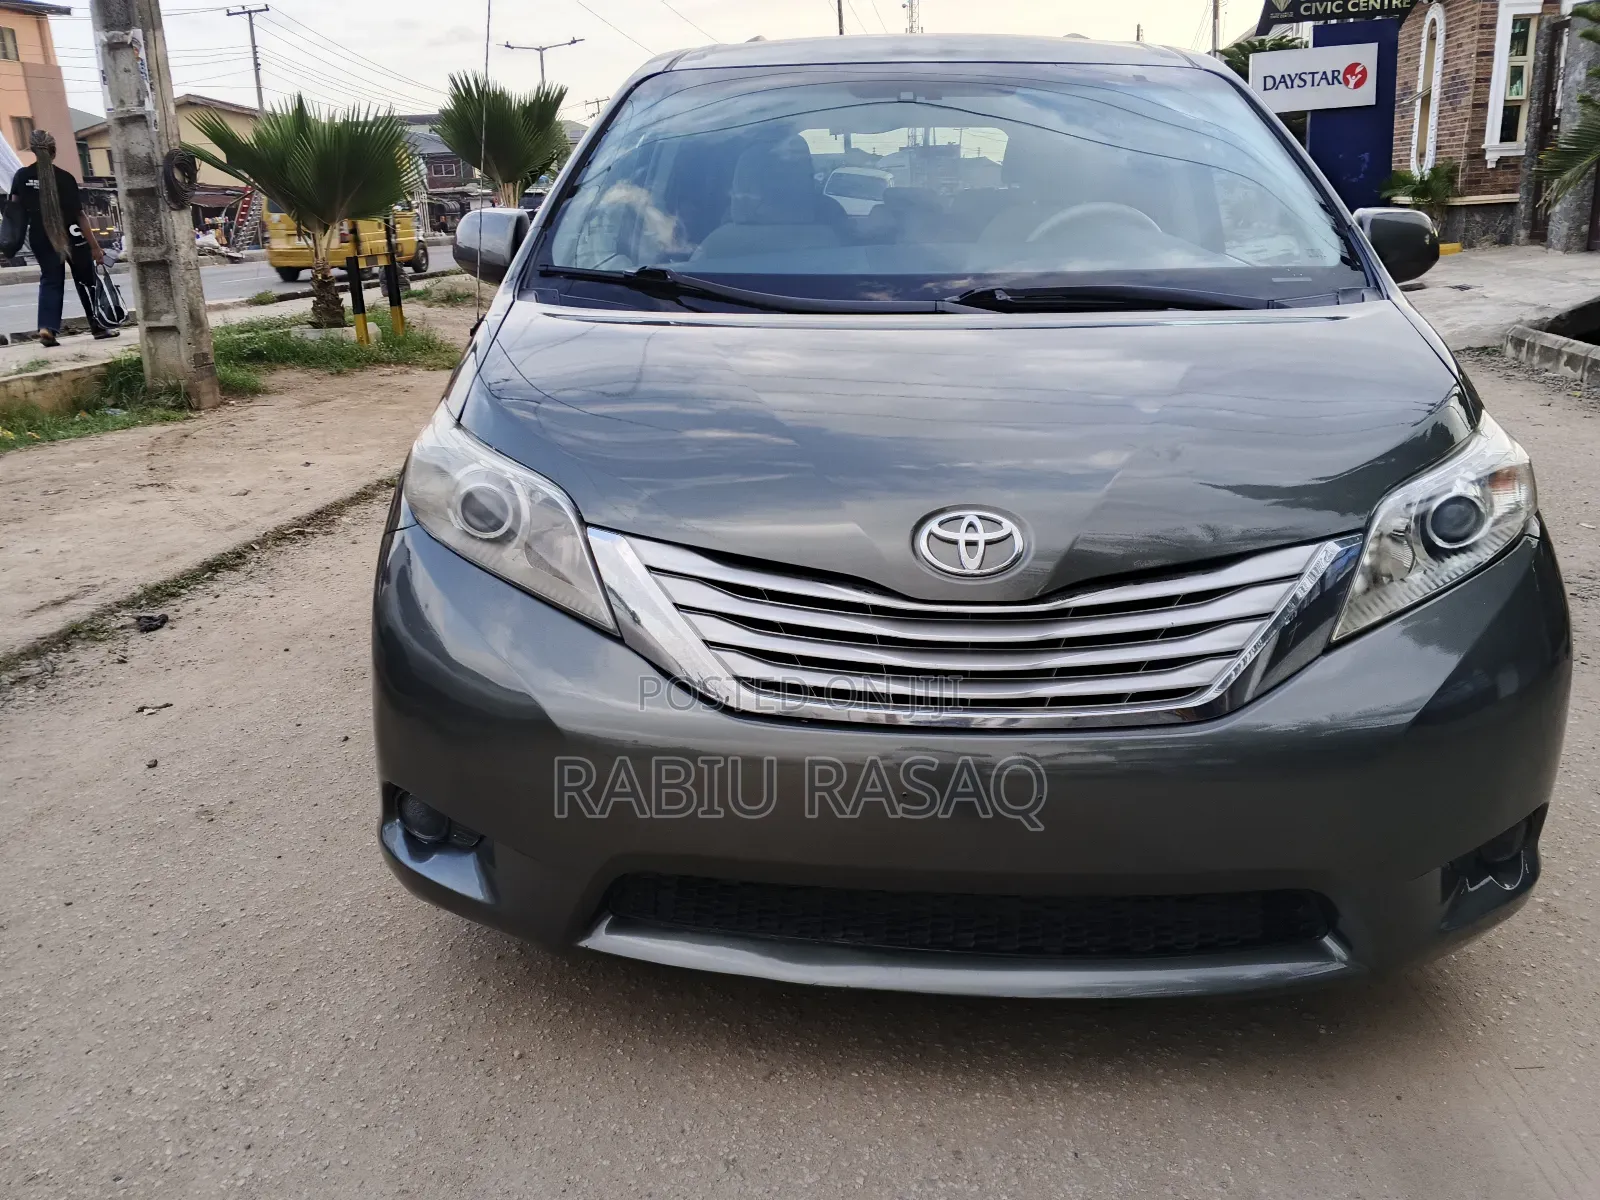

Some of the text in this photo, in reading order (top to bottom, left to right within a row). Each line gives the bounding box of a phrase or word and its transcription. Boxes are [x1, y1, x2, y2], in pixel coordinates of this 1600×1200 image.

[1300, 1, 1343, 16] CIVIC
[1347, 0, 1411, 12] CENTRE
[1262, 69, 1343, 91] DAYSTAR
